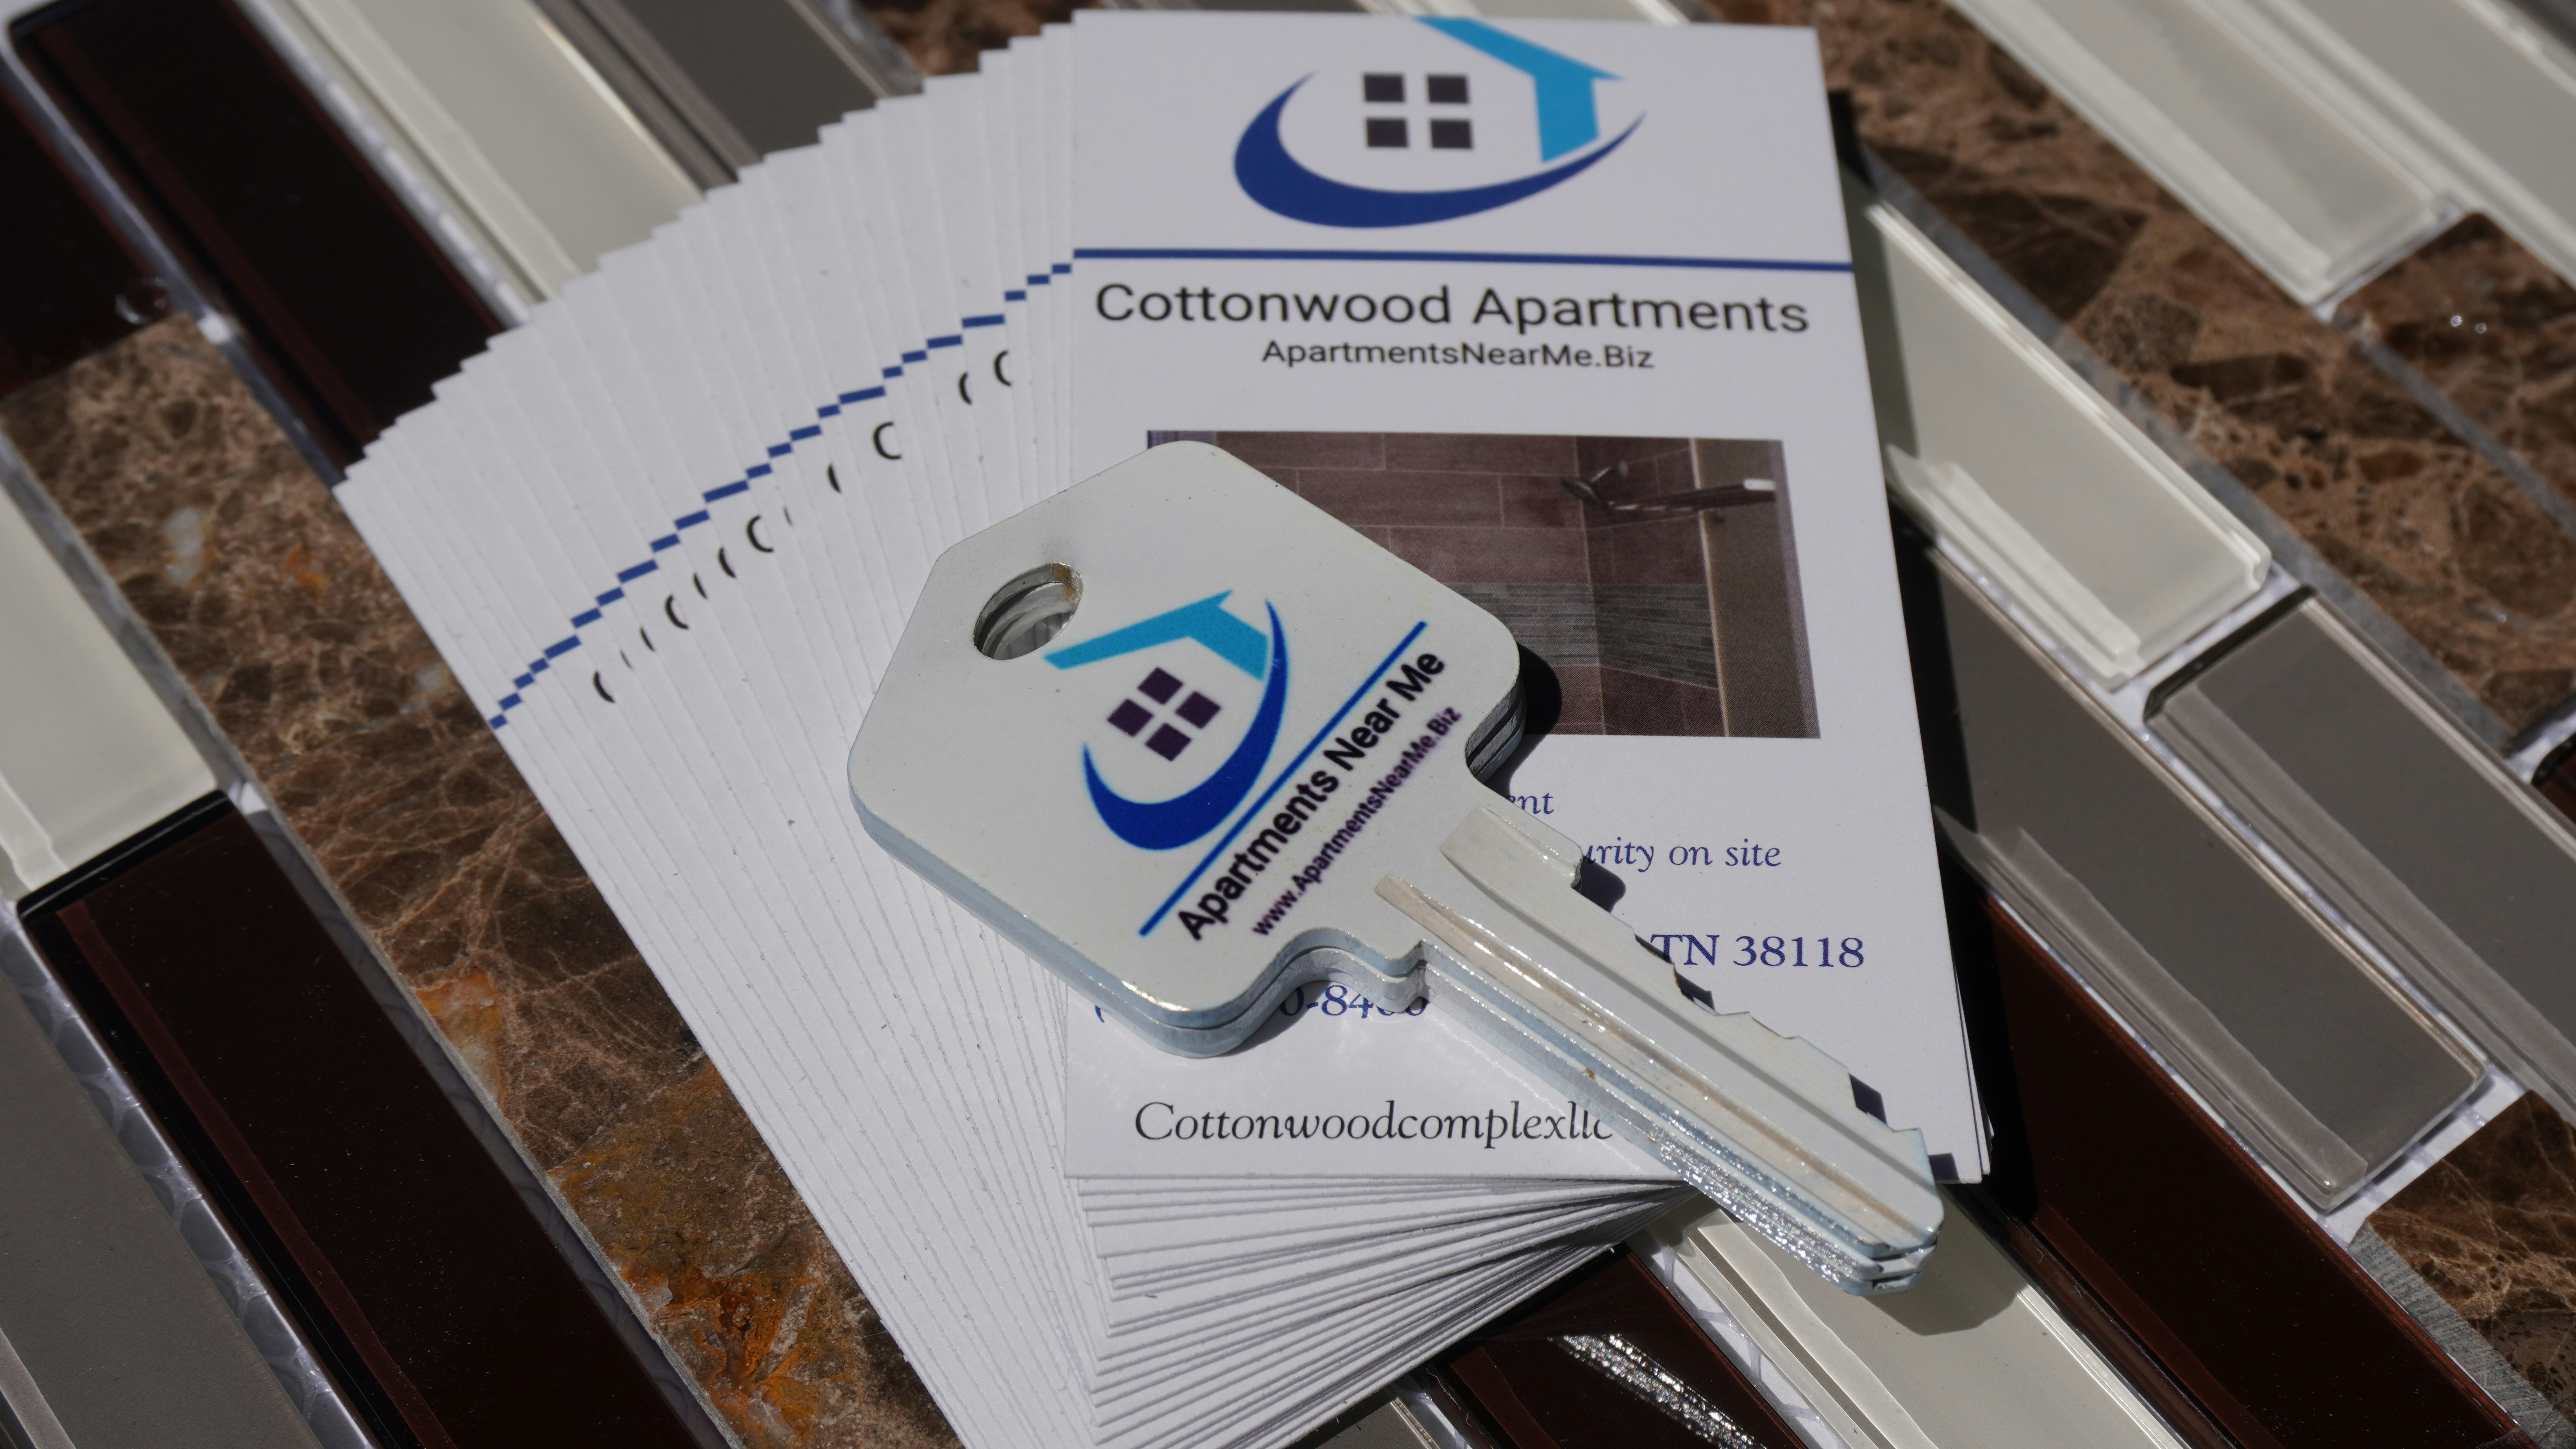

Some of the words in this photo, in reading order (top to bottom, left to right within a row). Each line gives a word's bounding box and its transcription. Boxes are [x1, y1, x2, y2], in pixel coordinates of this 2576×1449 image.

[1096, 283, 1451, 324] Cottonwood
[1473, 287, 1809, 336] Apartments
[1261, 340, 1654, 369] ApartmentsNearMe.Biz
[1179, 769, 1340, 941] Apartments
[1323, 697, 1400, 771] Near
[1385, 650, 1445, 702] Me
[1252, 706, 1462, 937] www.ApartmentsNearMe.Biz
[1668, 845, 1713, 866] on
[1725, 838, 1782, 867] site
[1650, 934, 1720, 966] TN
[1733, 935, 1865, 968] 38118
